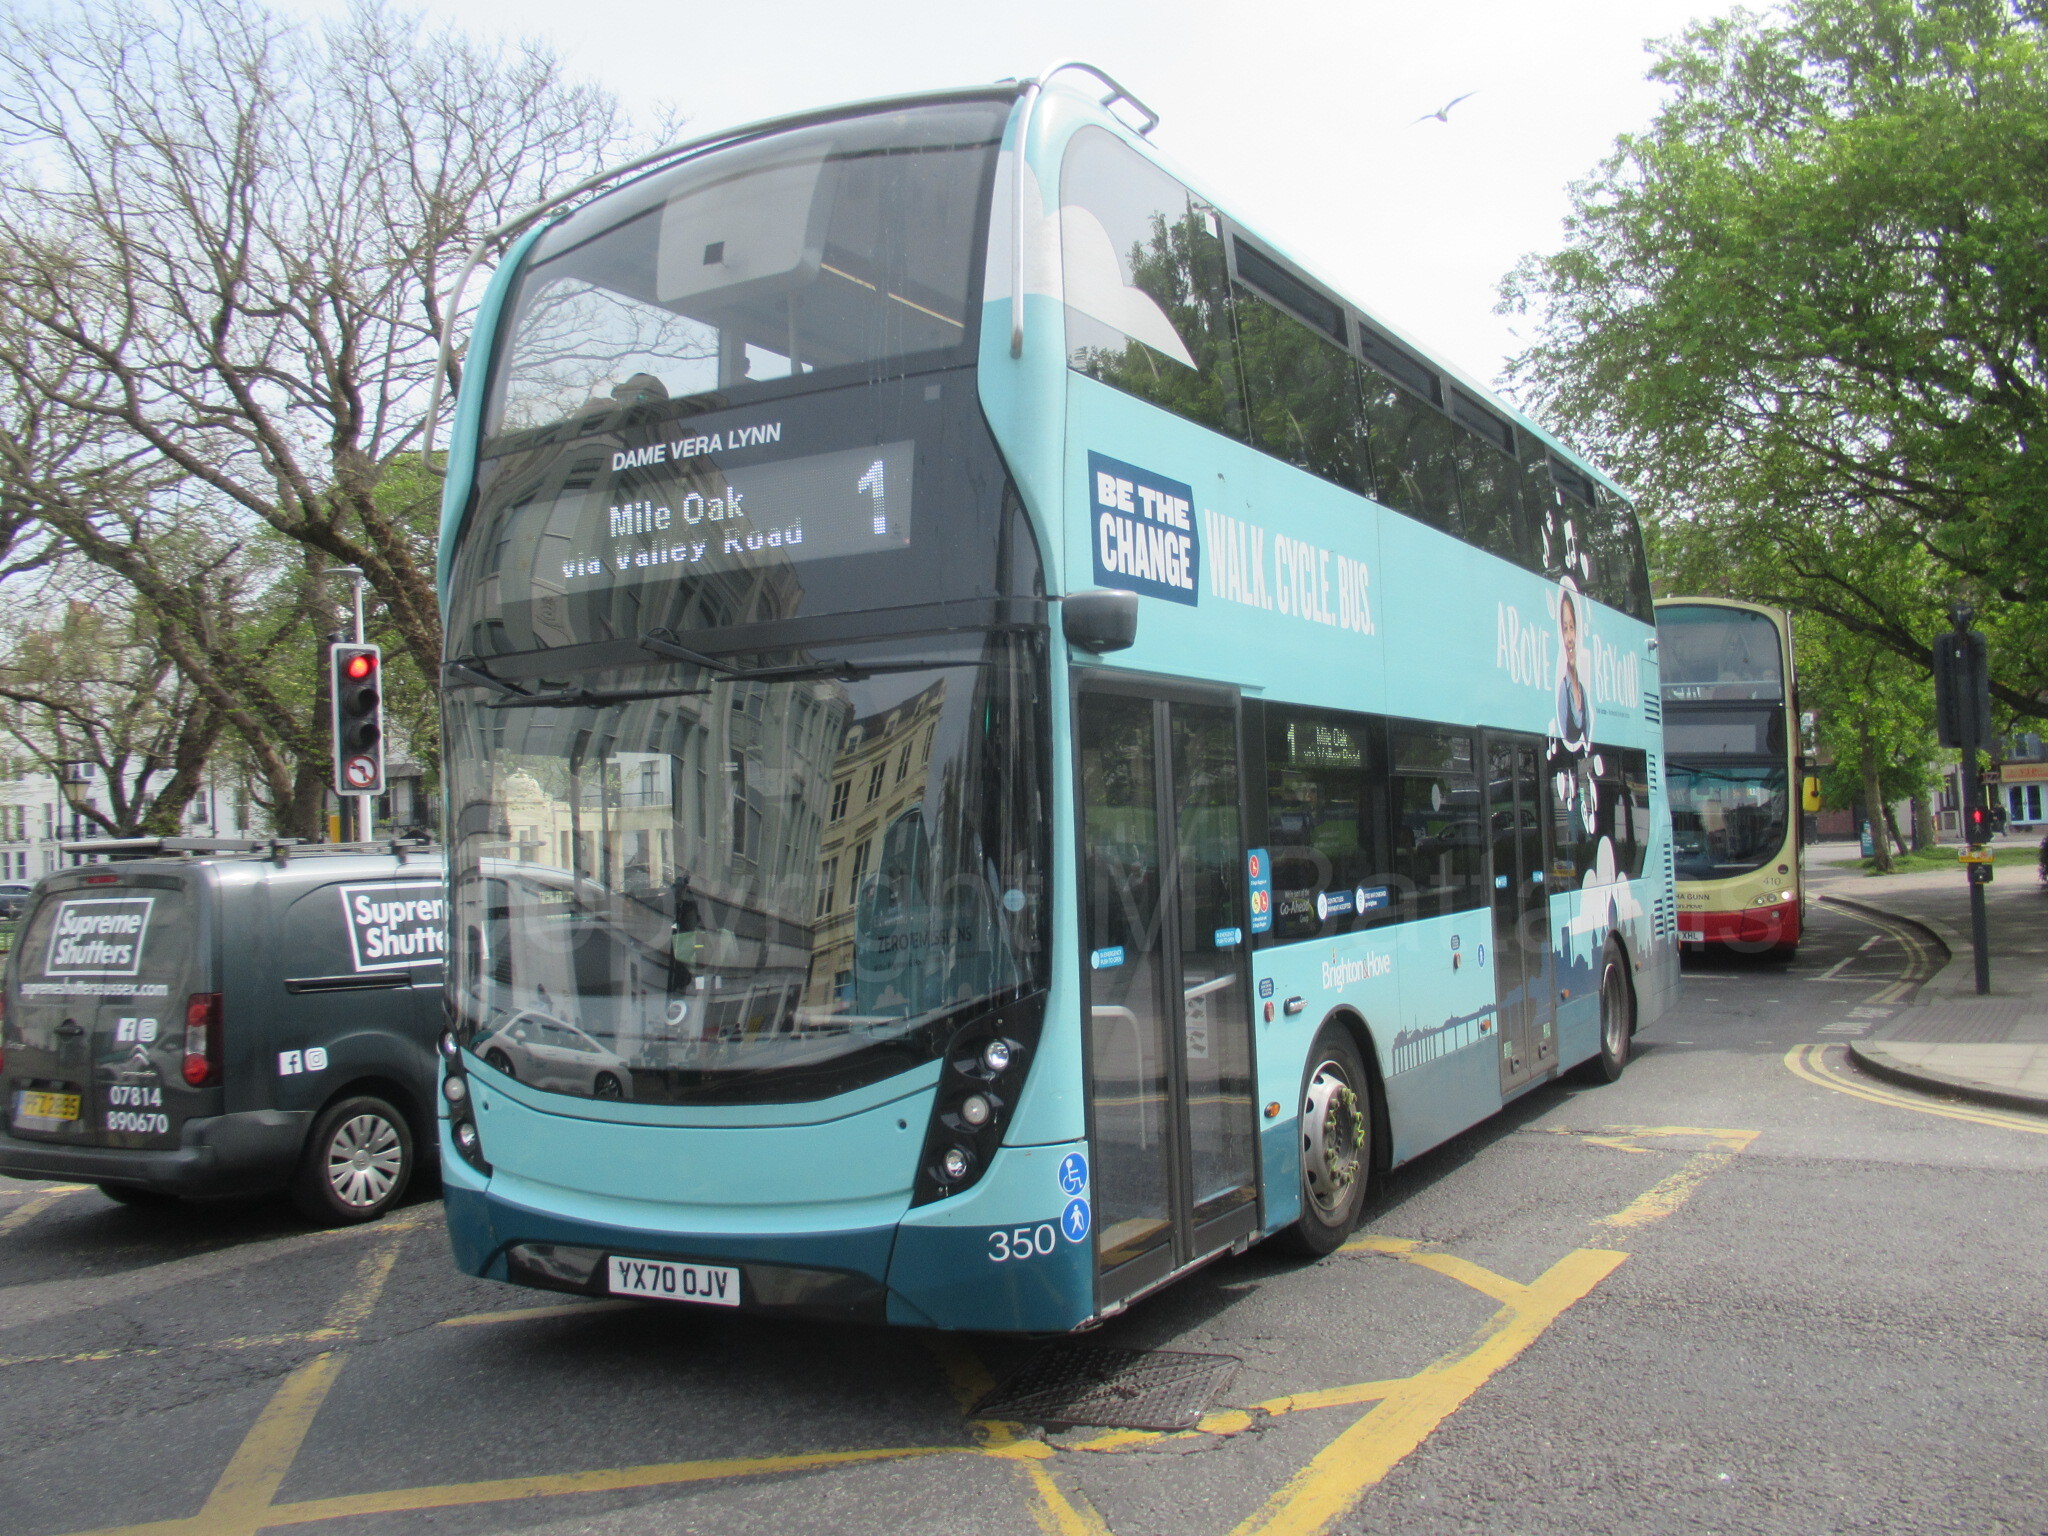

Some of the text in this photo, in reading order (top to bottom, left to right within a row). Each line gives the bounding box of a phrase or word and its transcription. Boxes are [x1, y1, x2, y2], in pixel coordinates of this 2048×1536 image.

[612, 422, 782, 472] DAME VERA LYNN
[609, 486, 745, 538] Mile Oak
[858, 459, 886, 535] 1
[1096, 471, 1191, 531] BE THE
[561, 517, 803, 579] via Valley Road
[1099, 512, 1193, 590] CHANGE
[1204, 508, 1375, 637] WALK. CYCLE. BUS.
[1496, 600, 1639, 709] ABOVE BEYOND
[59, 910, 142, 941] Supreme
[910, 926, 972, 949] EMISSINS
[1682, 932, 1698, 940] XHL
[54, 938, 133, 965] Shutters
[109, 1086, 163, 1107] 07814
[106, 1111, 170, 1134] 890670
[988, 1223, 1056, 1262] 350
[618, 1260, 729, 1299] YX70 OJV
